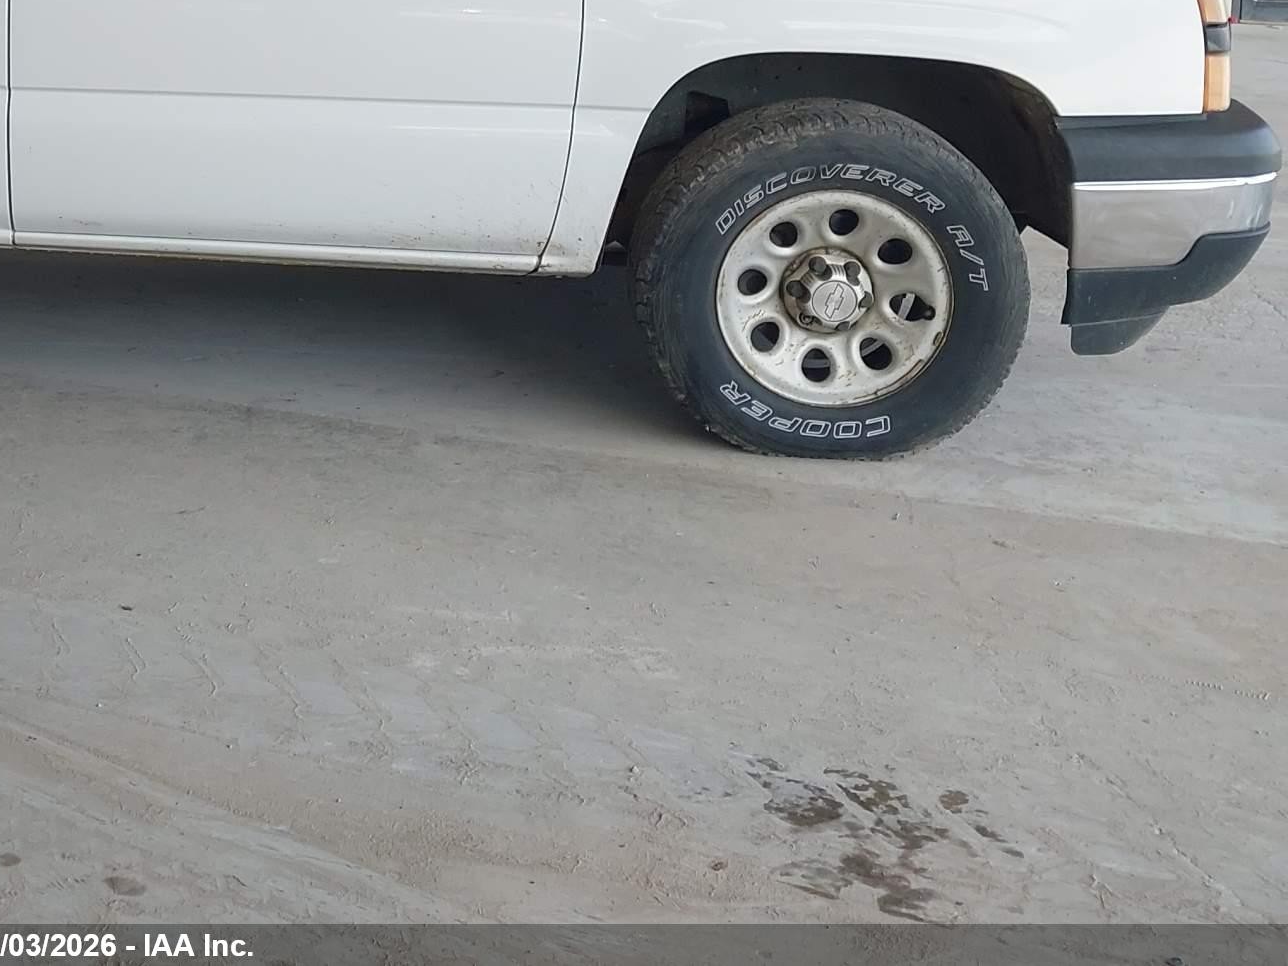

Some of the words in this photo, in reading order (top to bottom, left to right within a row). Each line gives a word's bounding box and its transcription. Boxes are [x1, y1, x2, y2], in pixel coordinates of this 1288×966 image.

[715, 163, 946, 235] DISCOVERER
[946, 224, 990, 292] A/T
[719, 380, 891, 440] COOPER
